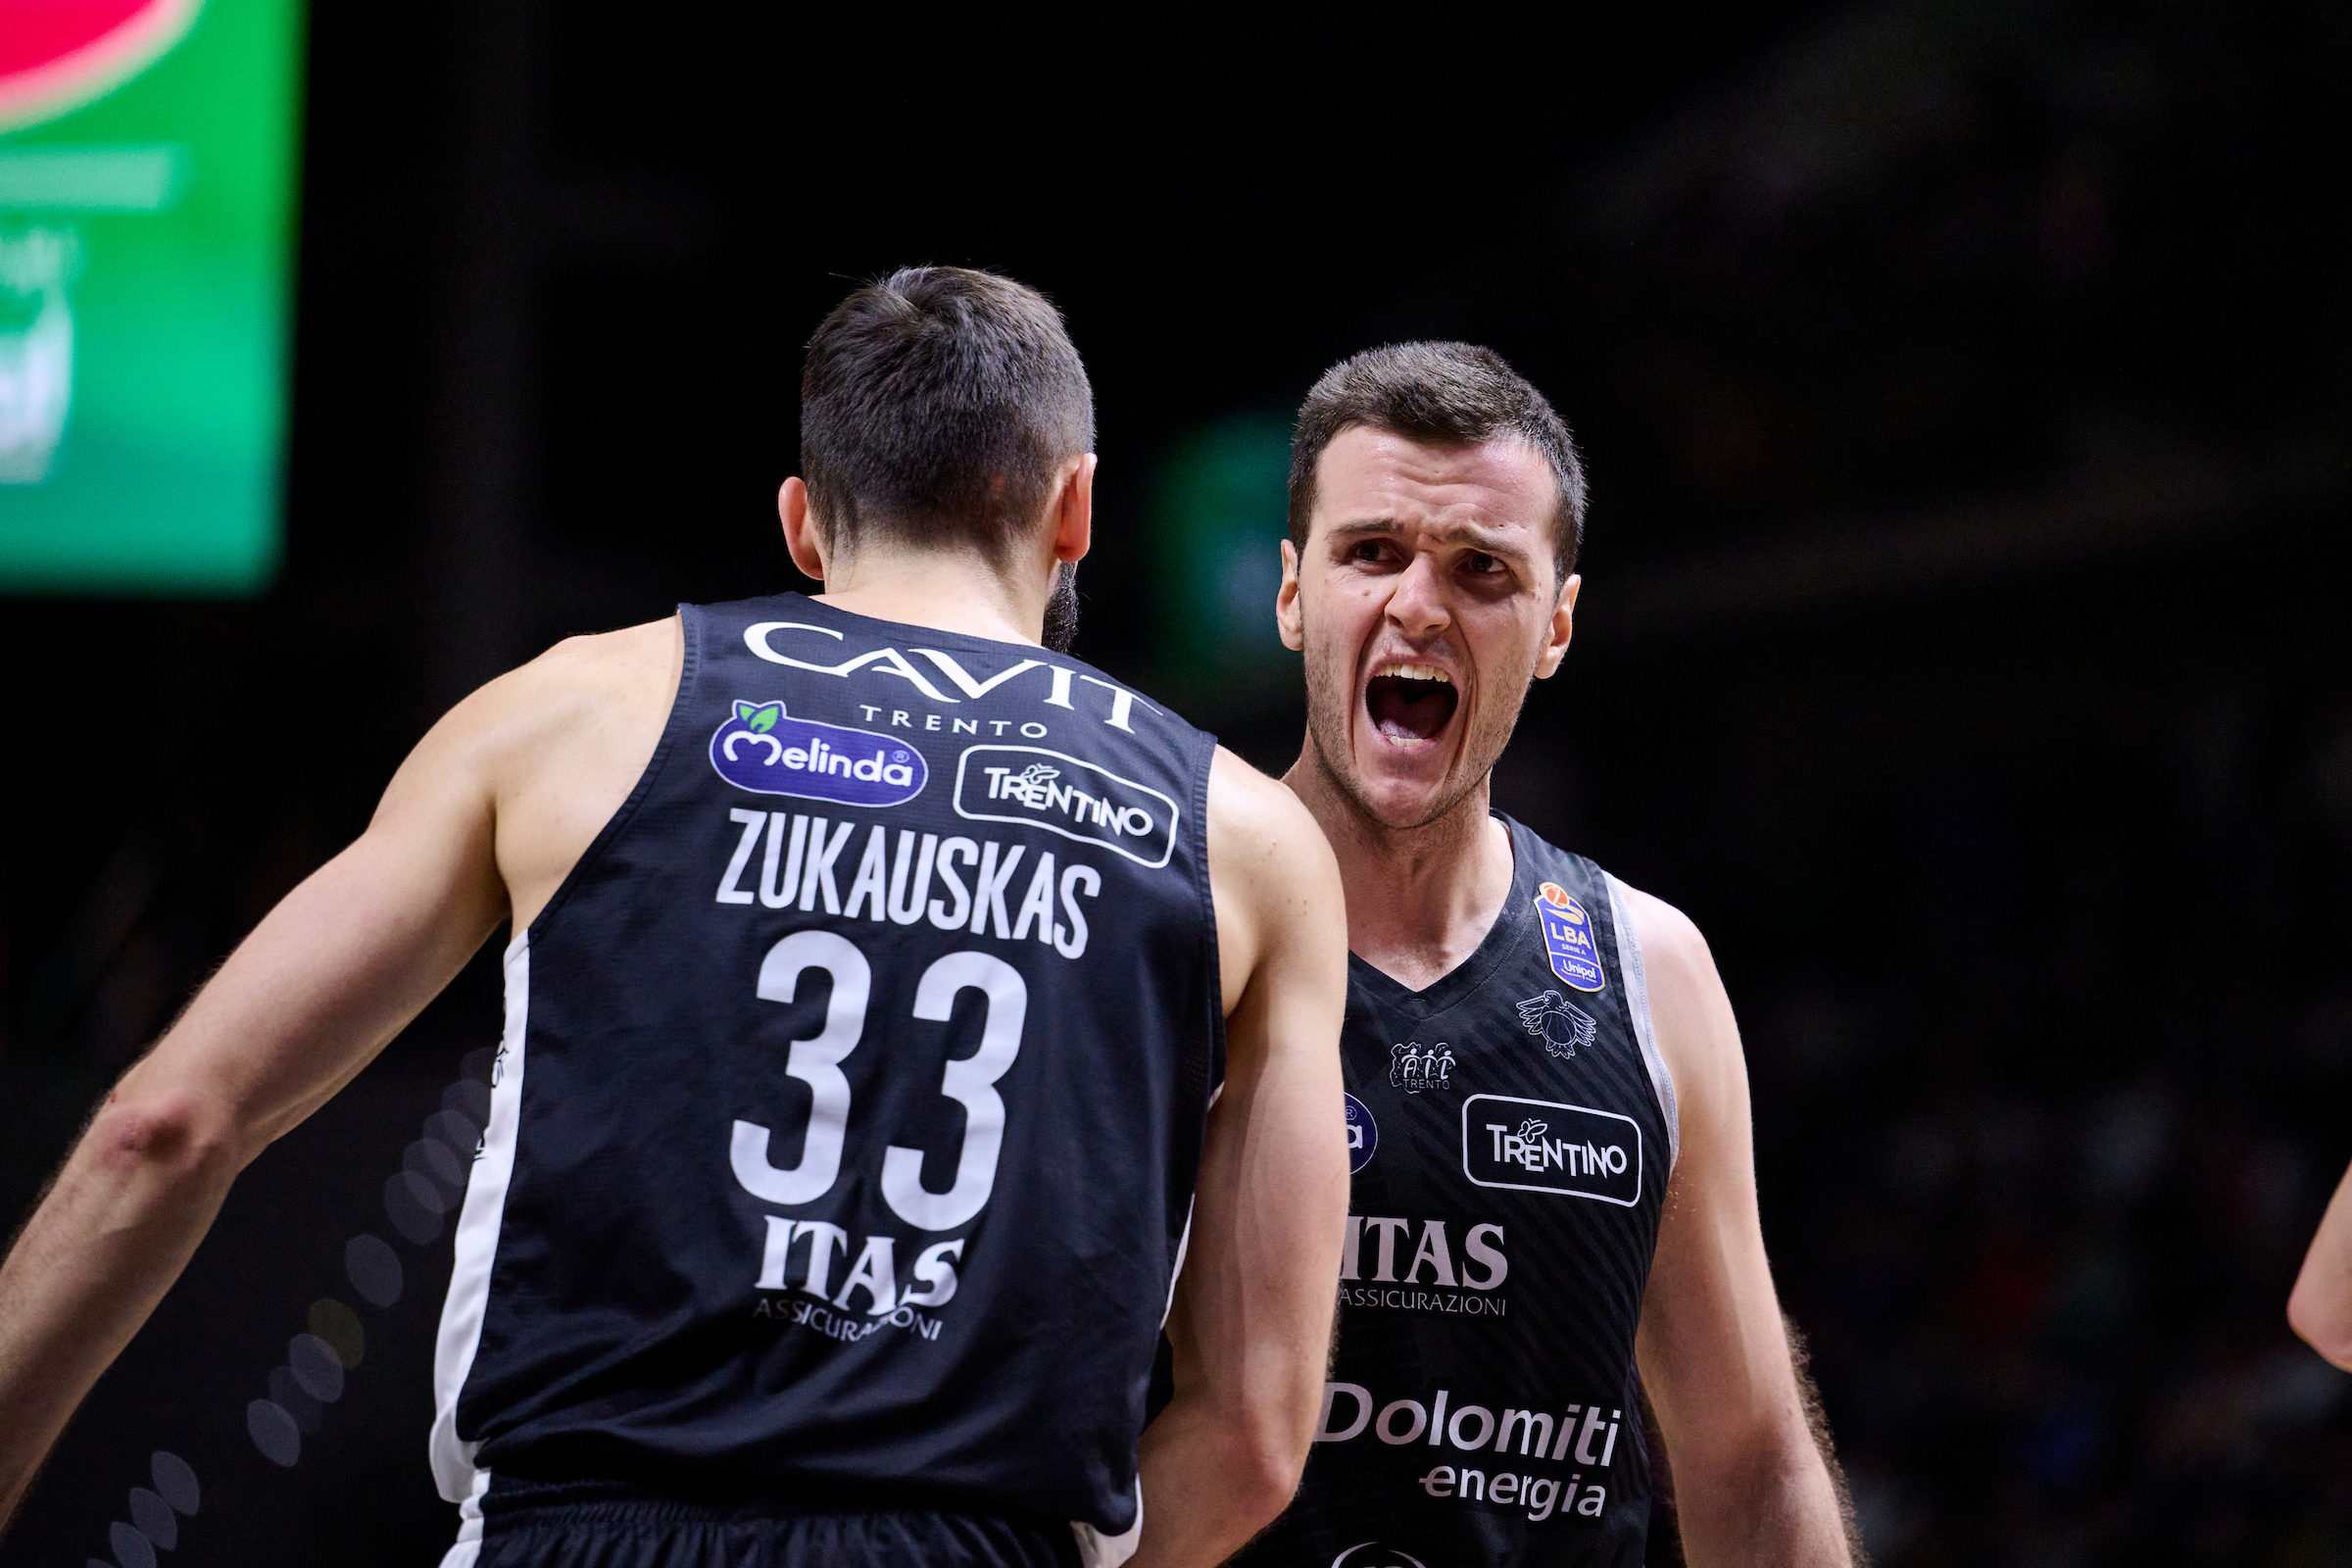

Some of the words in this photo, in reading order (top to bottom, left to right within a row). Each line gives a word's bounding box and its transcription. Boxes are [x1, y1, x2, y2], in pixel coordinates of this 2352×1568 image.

[742, 621, 1163, 734] CAVIT
[860, 704, 1048, 738] TRENTO
[984, 766, 1153, 837] TRENTINO
[715, 808, 1101, 959] ZUKAUSKAS
[1550, 921, 1592, 950] LBA
[1562, 958, 1596, 980] Unipol
[729, 930, 1028, 1231] 33
[1402, 1078, 1450, 1090] TRENTO
[1486, 1124, 1627, 1179] TRENTINO
[755, 1214, 965, 1316] ITAS
[1339, 1215, 1508, 1291] ITAS
[1338, 1288, 1506, 1316] ASSICURAZIONI
[1313, 1382, 1621, 1467] Dolomiti
[1418, 1464, 1606, 1522] energia
